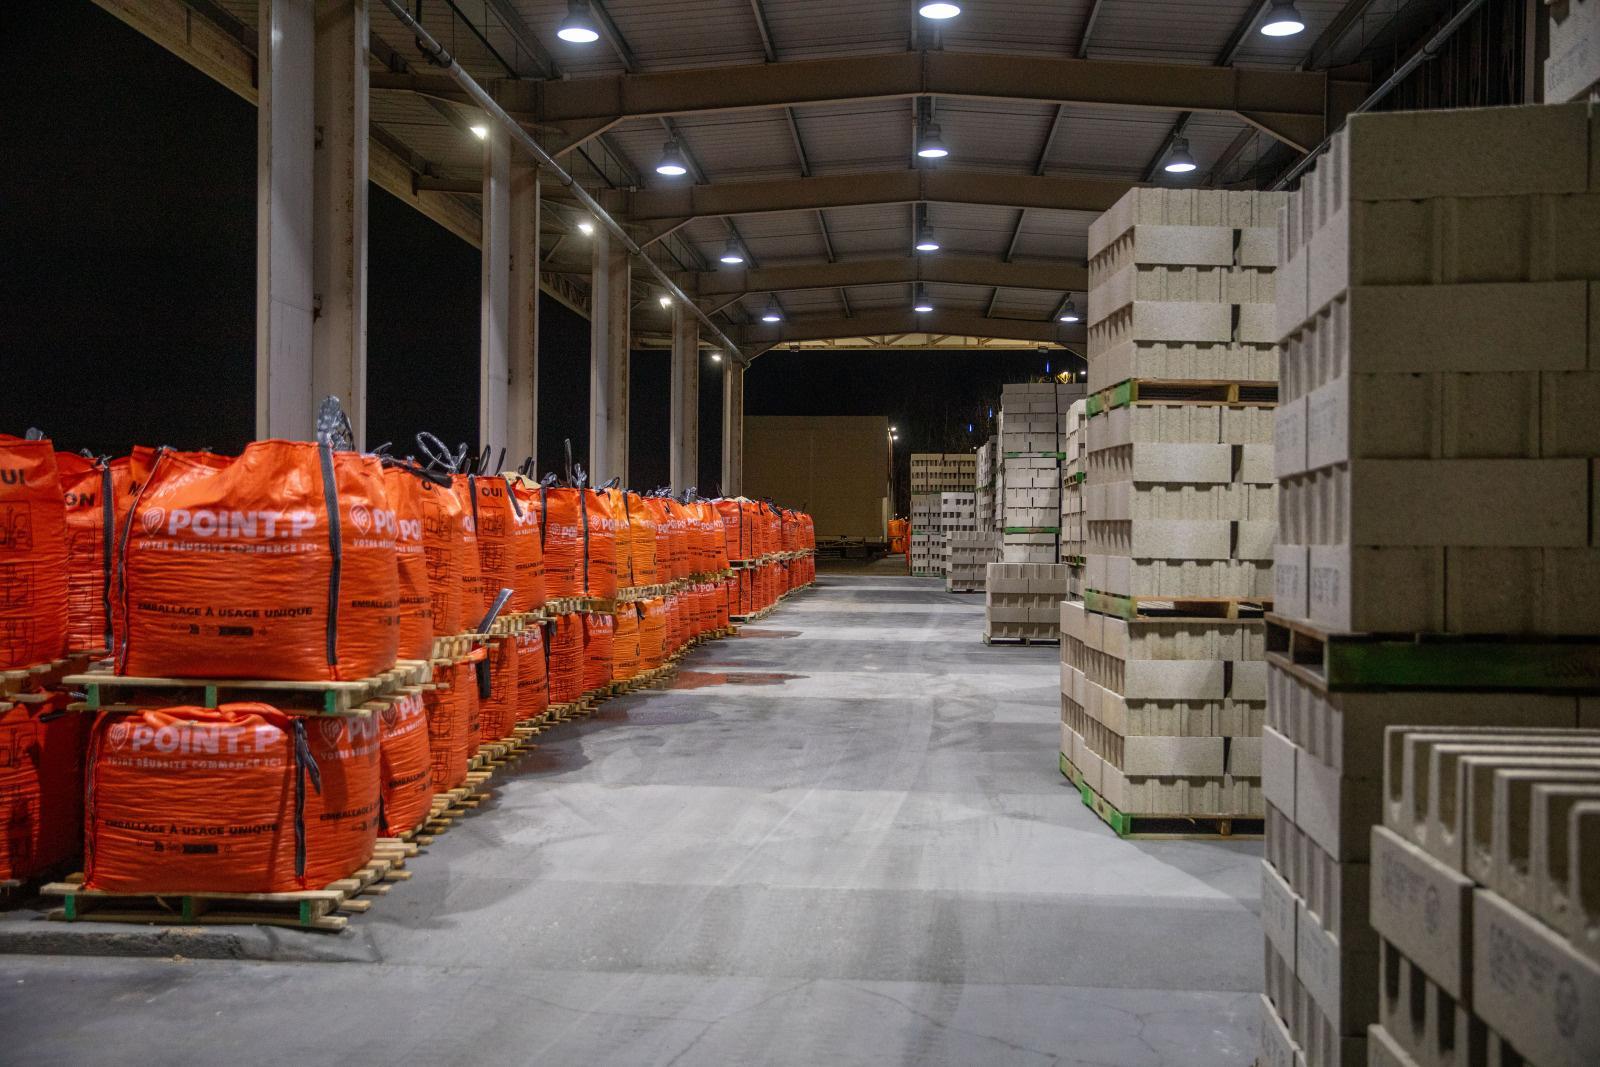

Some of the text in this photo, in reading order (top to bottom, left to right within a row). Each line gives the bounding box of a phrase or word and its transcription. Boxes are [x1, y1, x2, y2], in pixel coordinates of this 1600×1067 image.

[481, 487, 503, 497] OUI
[168, 509, 317, 538] POINT.P
[137, 602, 202, 617] EMBALLAGE
[218, 608, 260, 618] USAGE
[264, 606, 313, 618] UNIQUE
[132, 724, 280, 754] POINT.P
[105, 819, 164, 833] EMBALLAGE
[183, 825, 225, 836] USAGE
[229, 823, 280, 836] UNIQUE
